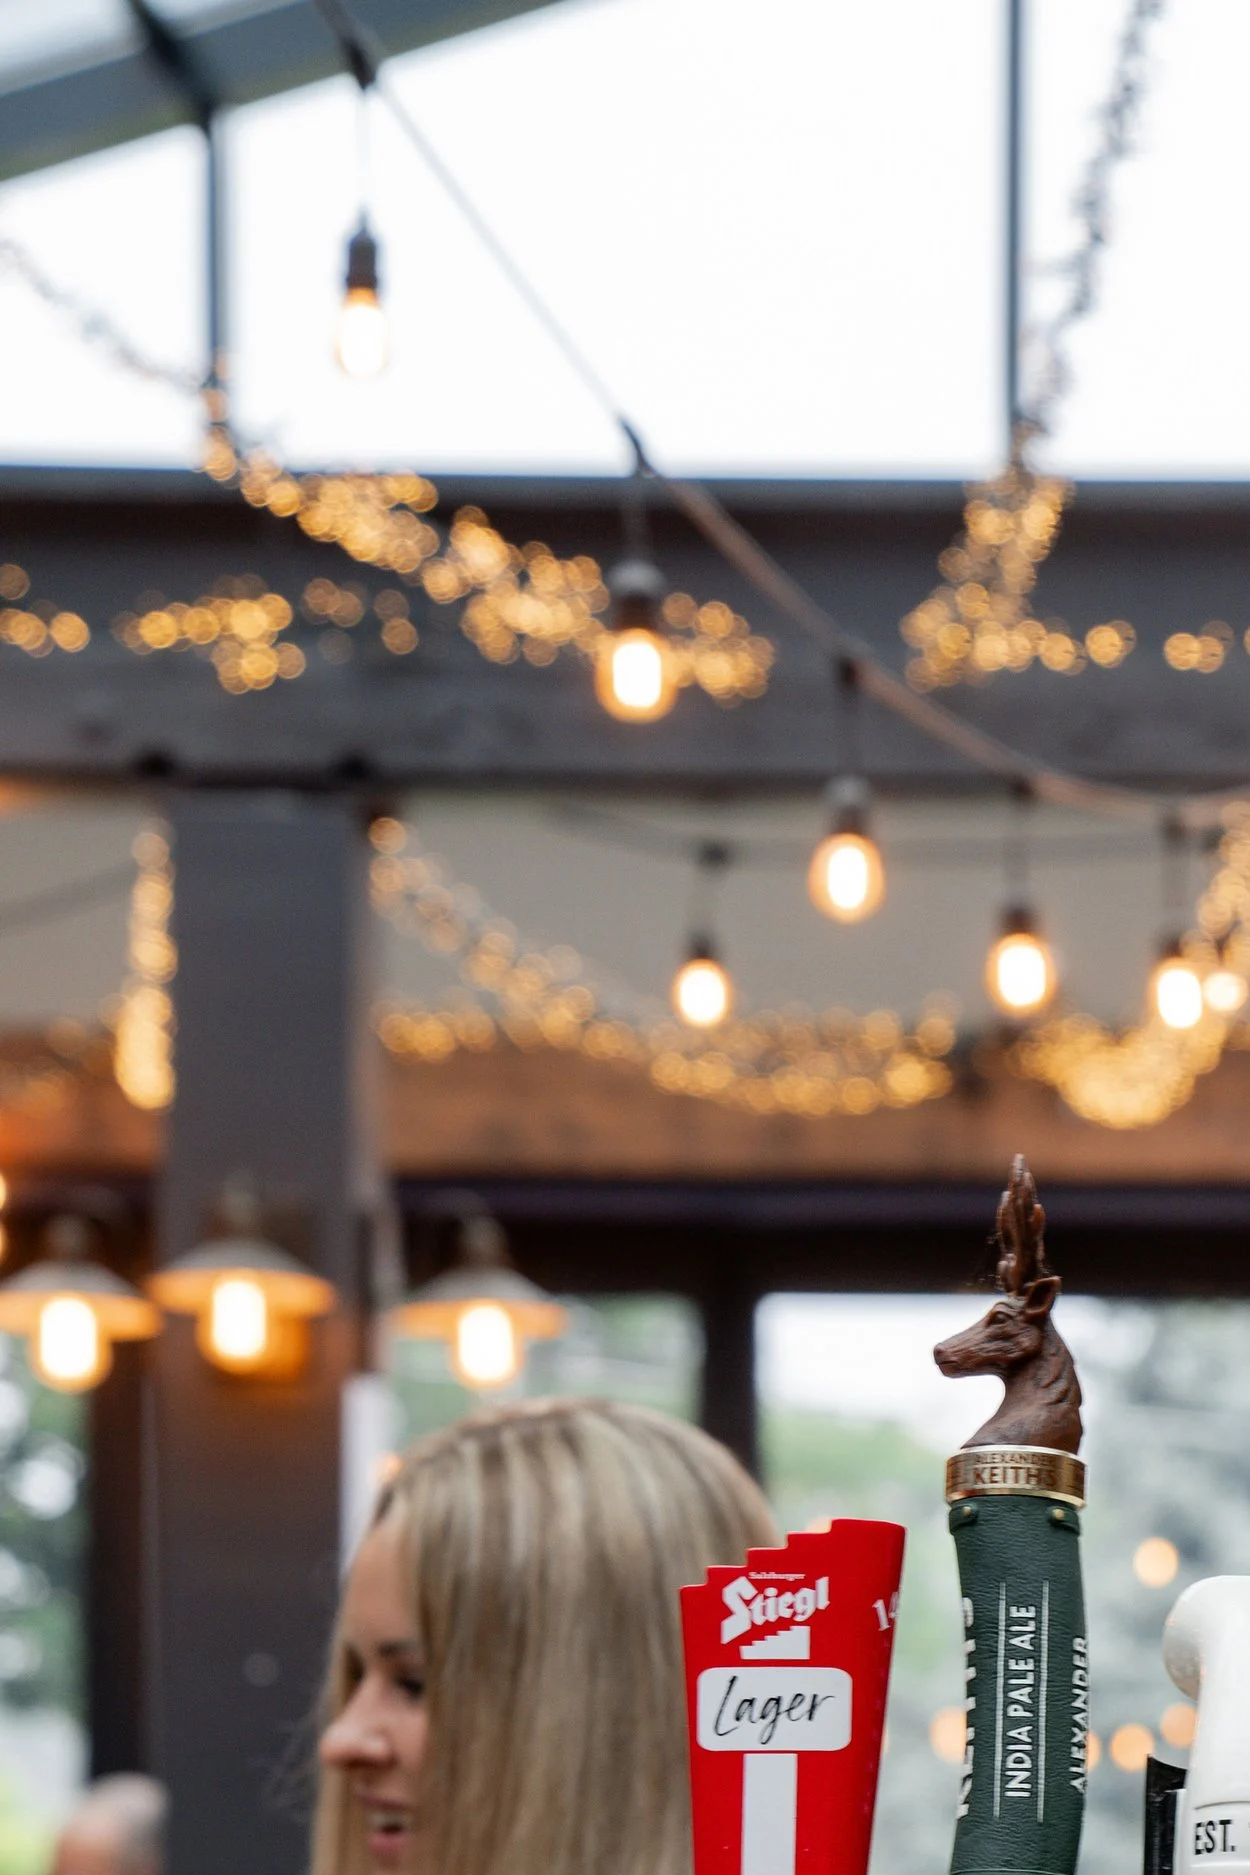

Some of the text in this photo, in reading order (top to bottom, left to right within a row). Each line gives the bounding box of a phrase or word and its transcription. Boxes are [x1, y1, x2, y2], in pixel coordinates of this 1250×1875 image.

[720, 1575, 830, 1645] Stiegl
[714, 1675, 835, 1745] Lager
[1004, 1604, 1037, 1798] INDIA PALE ALE
[1194, 1819, 1237, 1855] EST.
